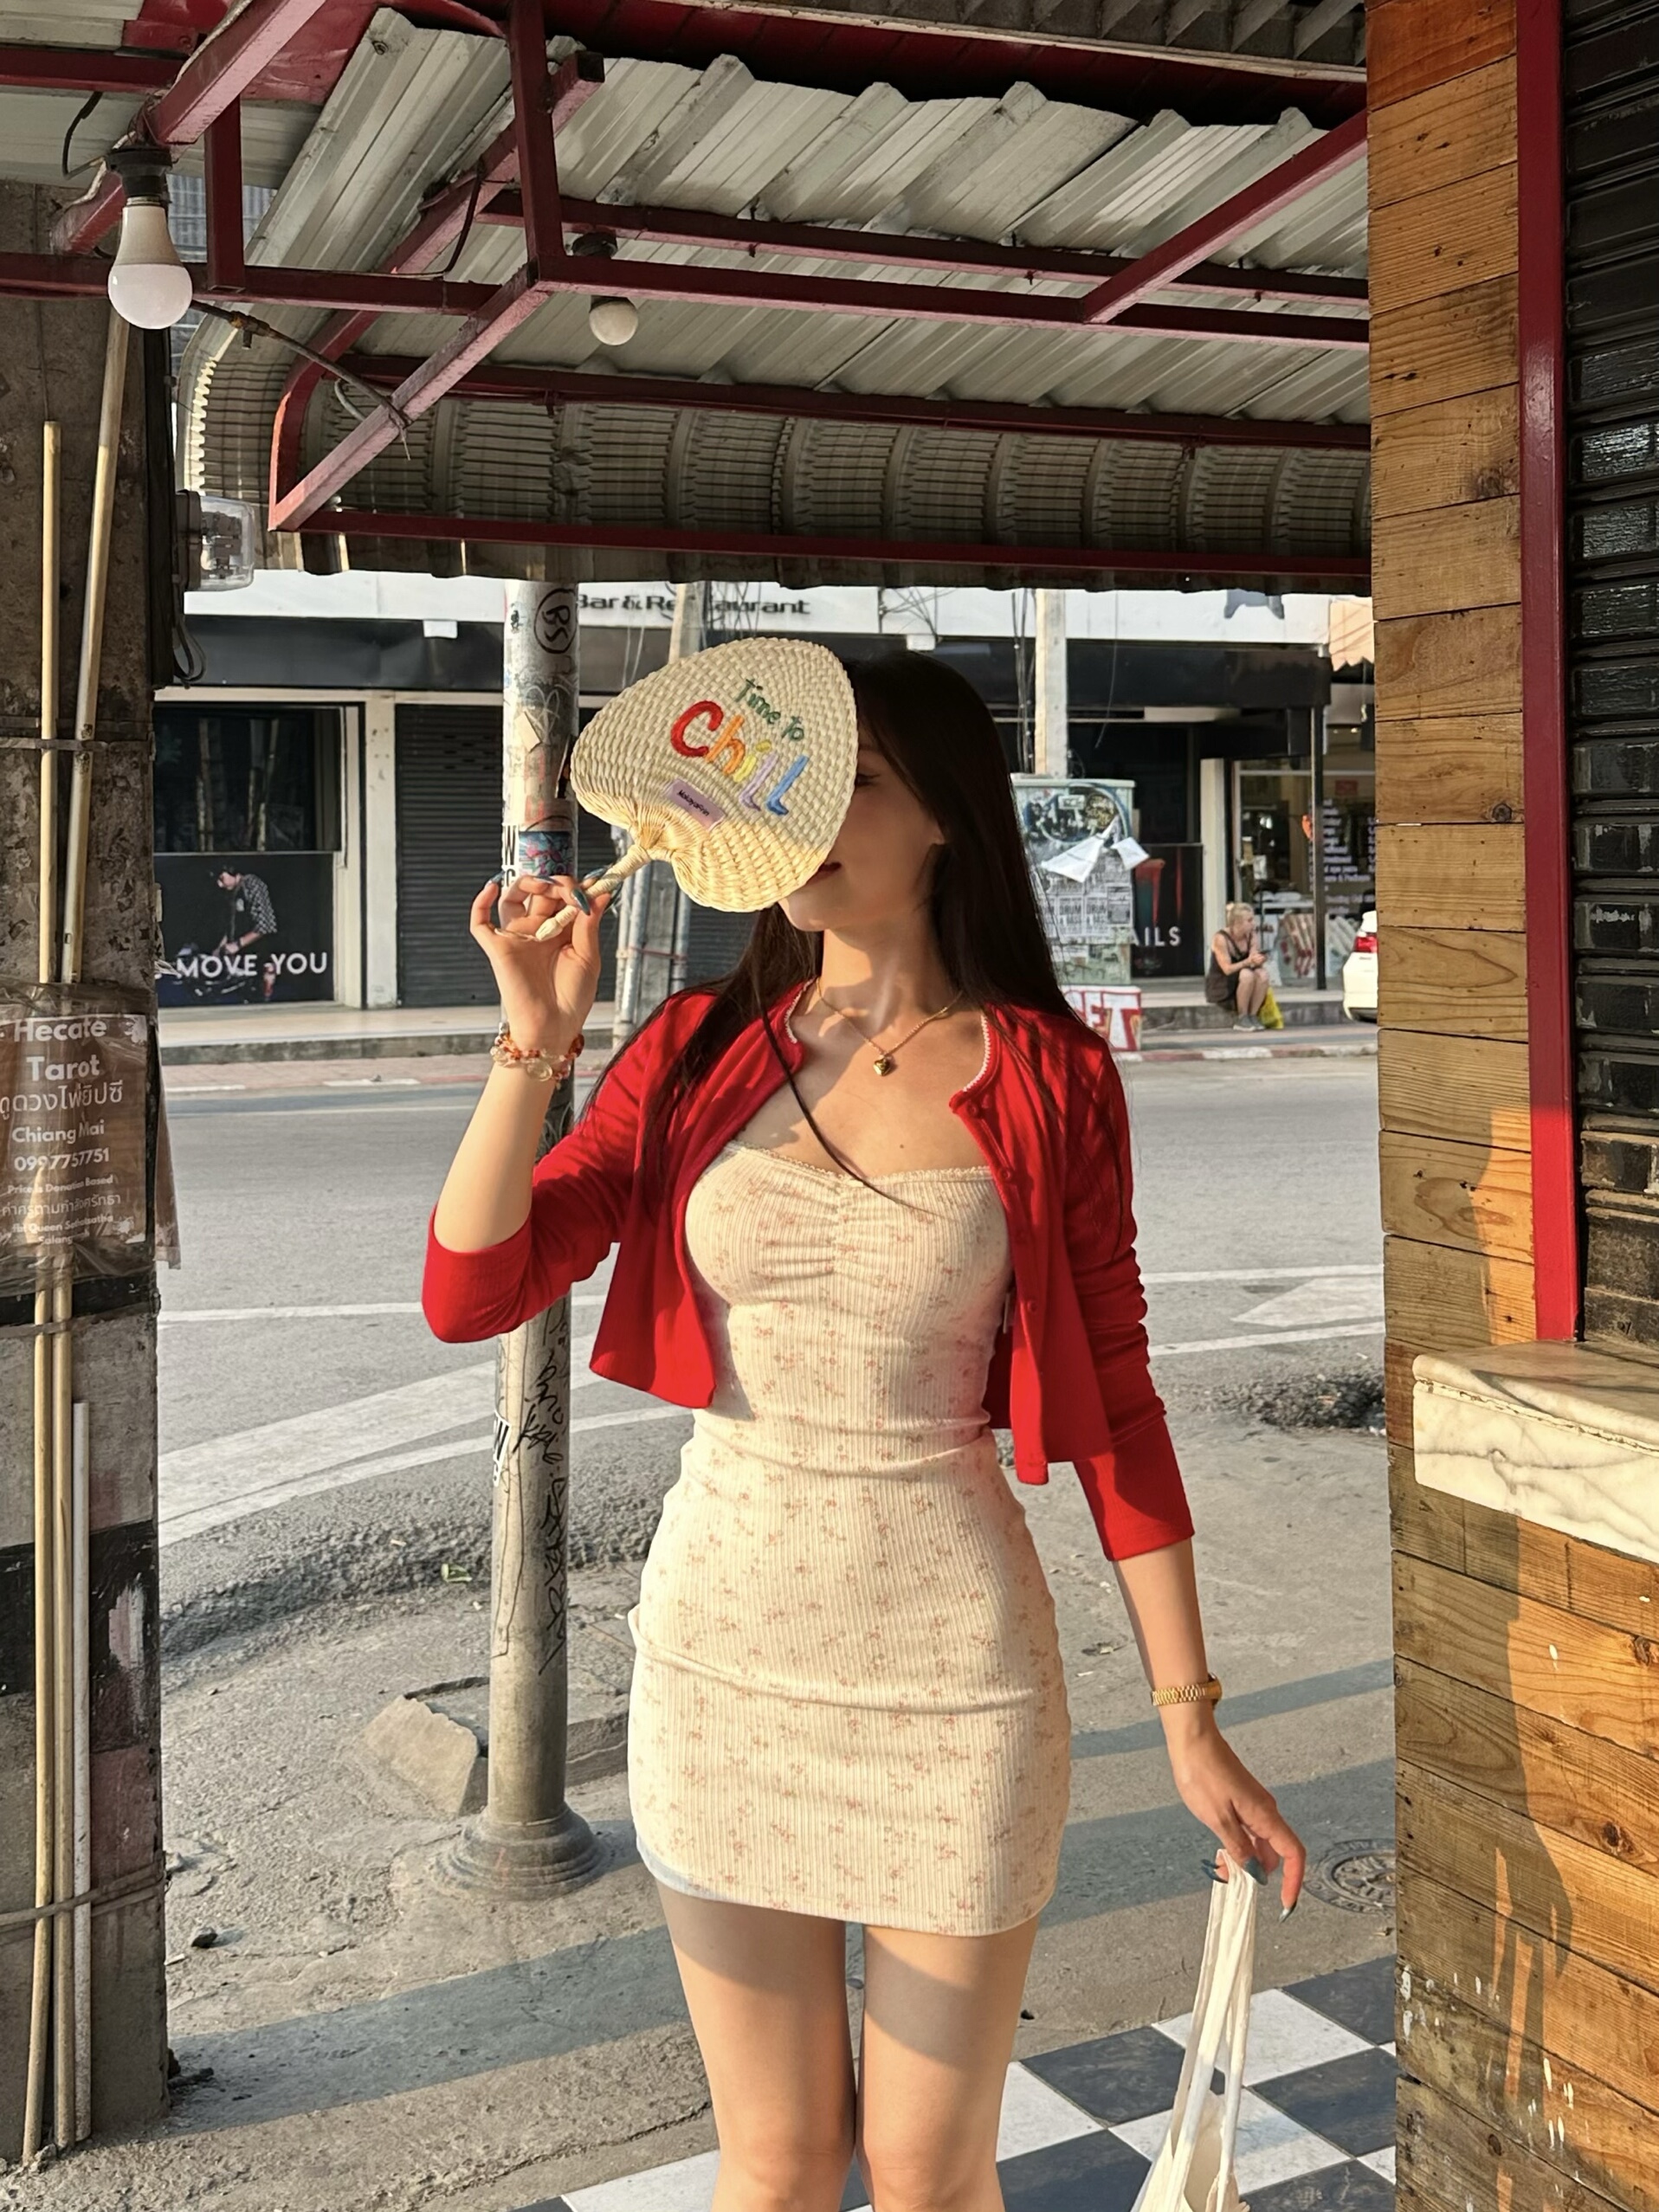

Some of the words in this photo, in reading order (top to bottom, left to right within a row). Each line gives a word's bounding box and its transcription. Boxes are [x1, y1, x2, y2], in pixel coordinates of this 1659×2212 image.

[645, 596, 811, 616] Reaurant
[734, 678, 783, 725] Time
[781, 715, 805, 741] to
[176, 953, 258, 978] MOVE
[270, 951, 328, 975] YOU
[13, 1017, 108, 1042] Hecate
[25, 1054, 100, 1082] Tarot
[11, 1126, 77, 1145] Chiang
[78, 1119, 106, 1139] Mai
